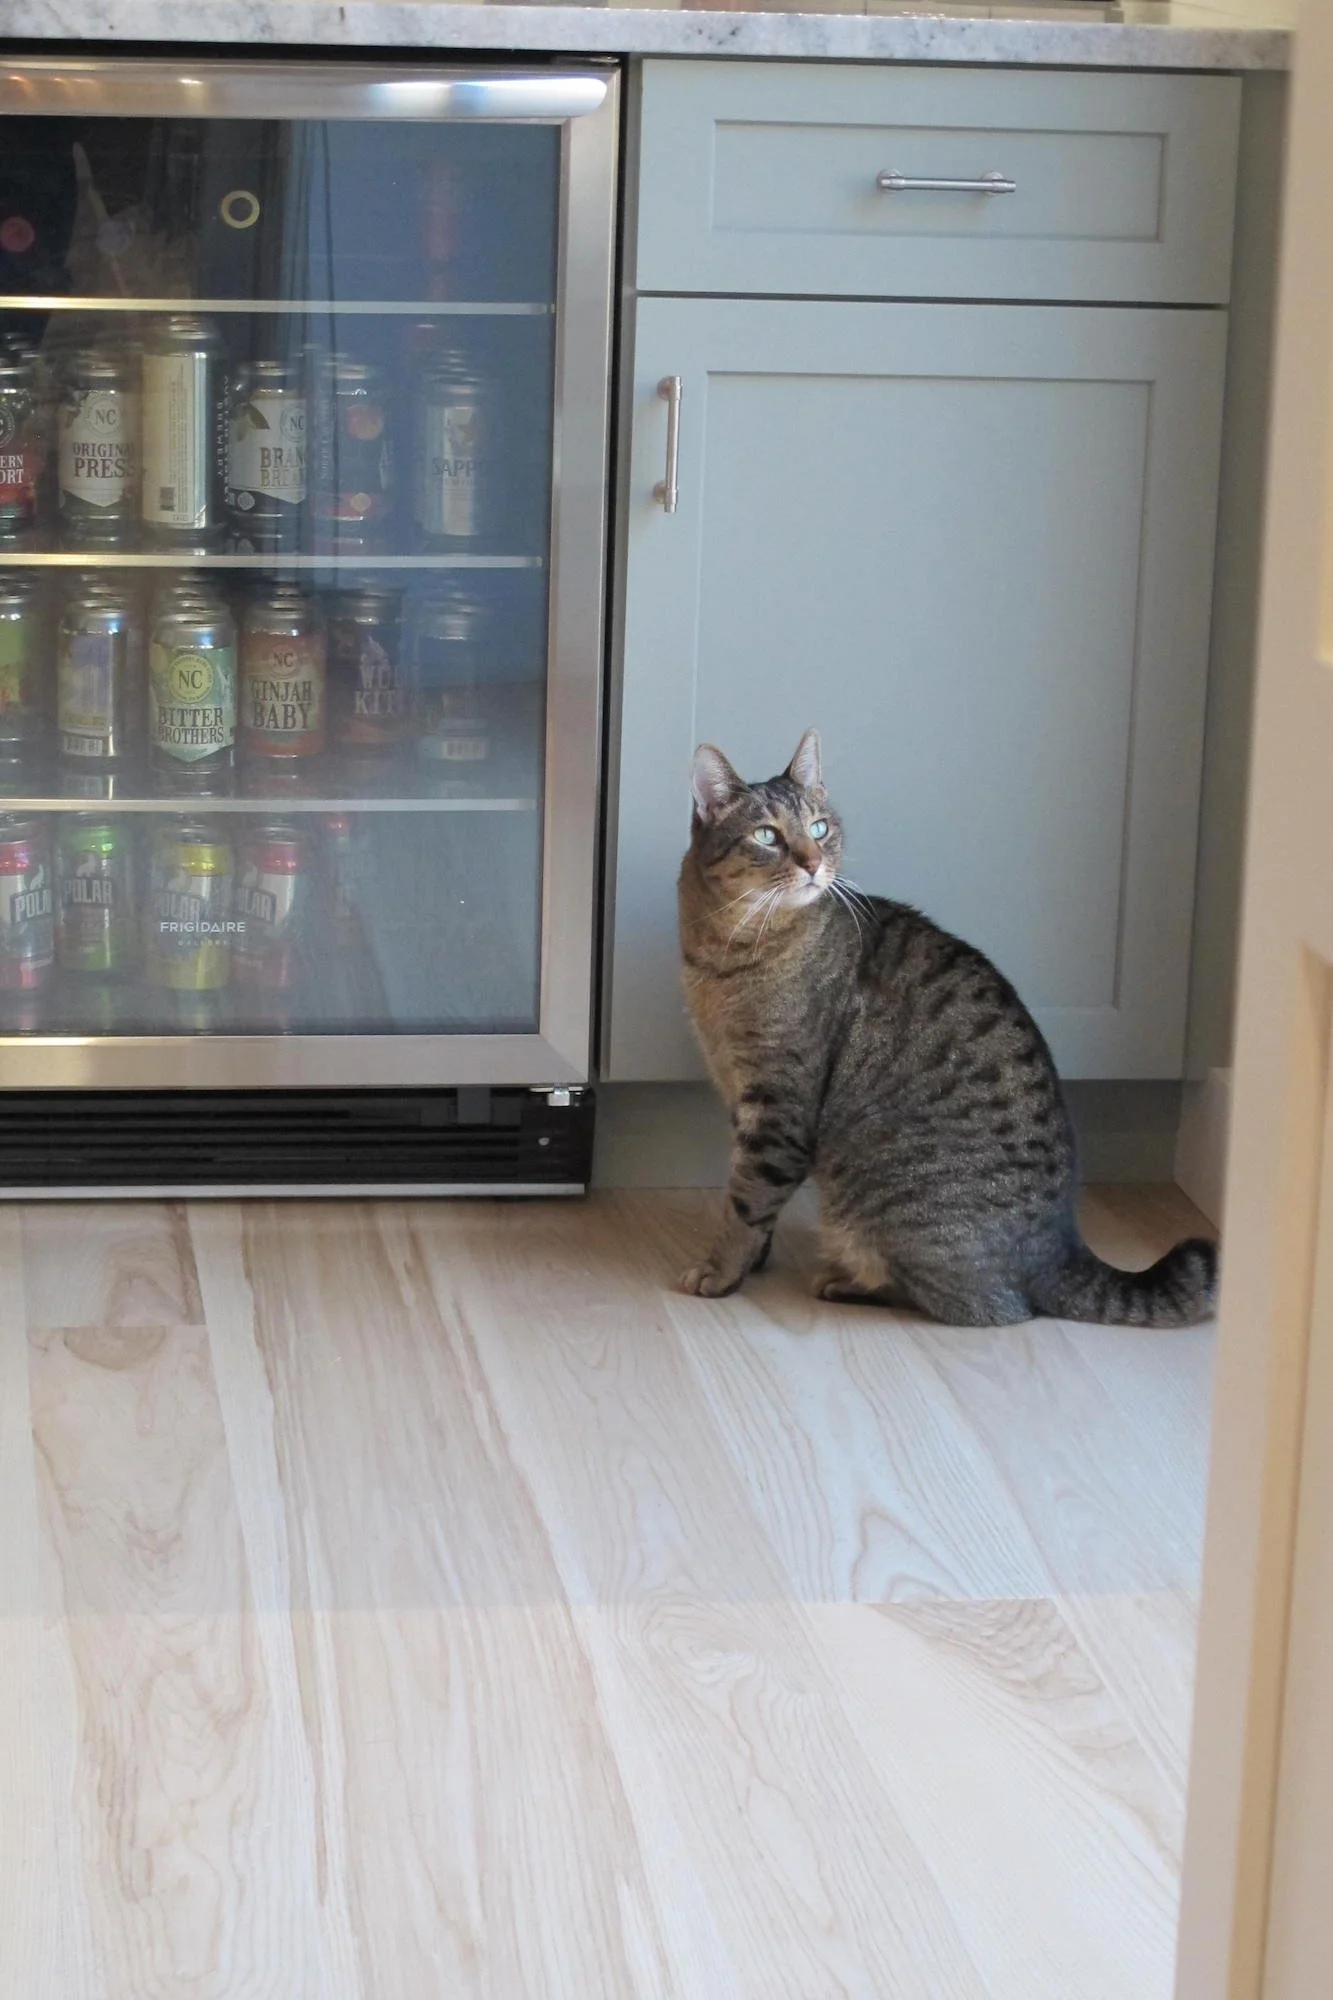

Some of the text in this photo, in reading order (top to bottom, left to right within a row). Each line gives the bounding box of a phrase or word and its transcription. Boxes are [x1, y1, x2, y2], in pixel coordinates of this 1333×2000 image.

[95, 409, 117, 425] NC
[273, 652, 294, 667] NC
[179, 670, 203, 689] NC
[250, 680, 313, 702] GINJAH
[158, 706, 224, 727] BITTER
[253, 701, 313, 729] BABY
[158, 726, 225, 745] BROTHERS
[64, 878, 112, 904] POLAR
[15, 889, 52, 923] POLA
[160, 921, 247, 933] FRIGIDAIRE
